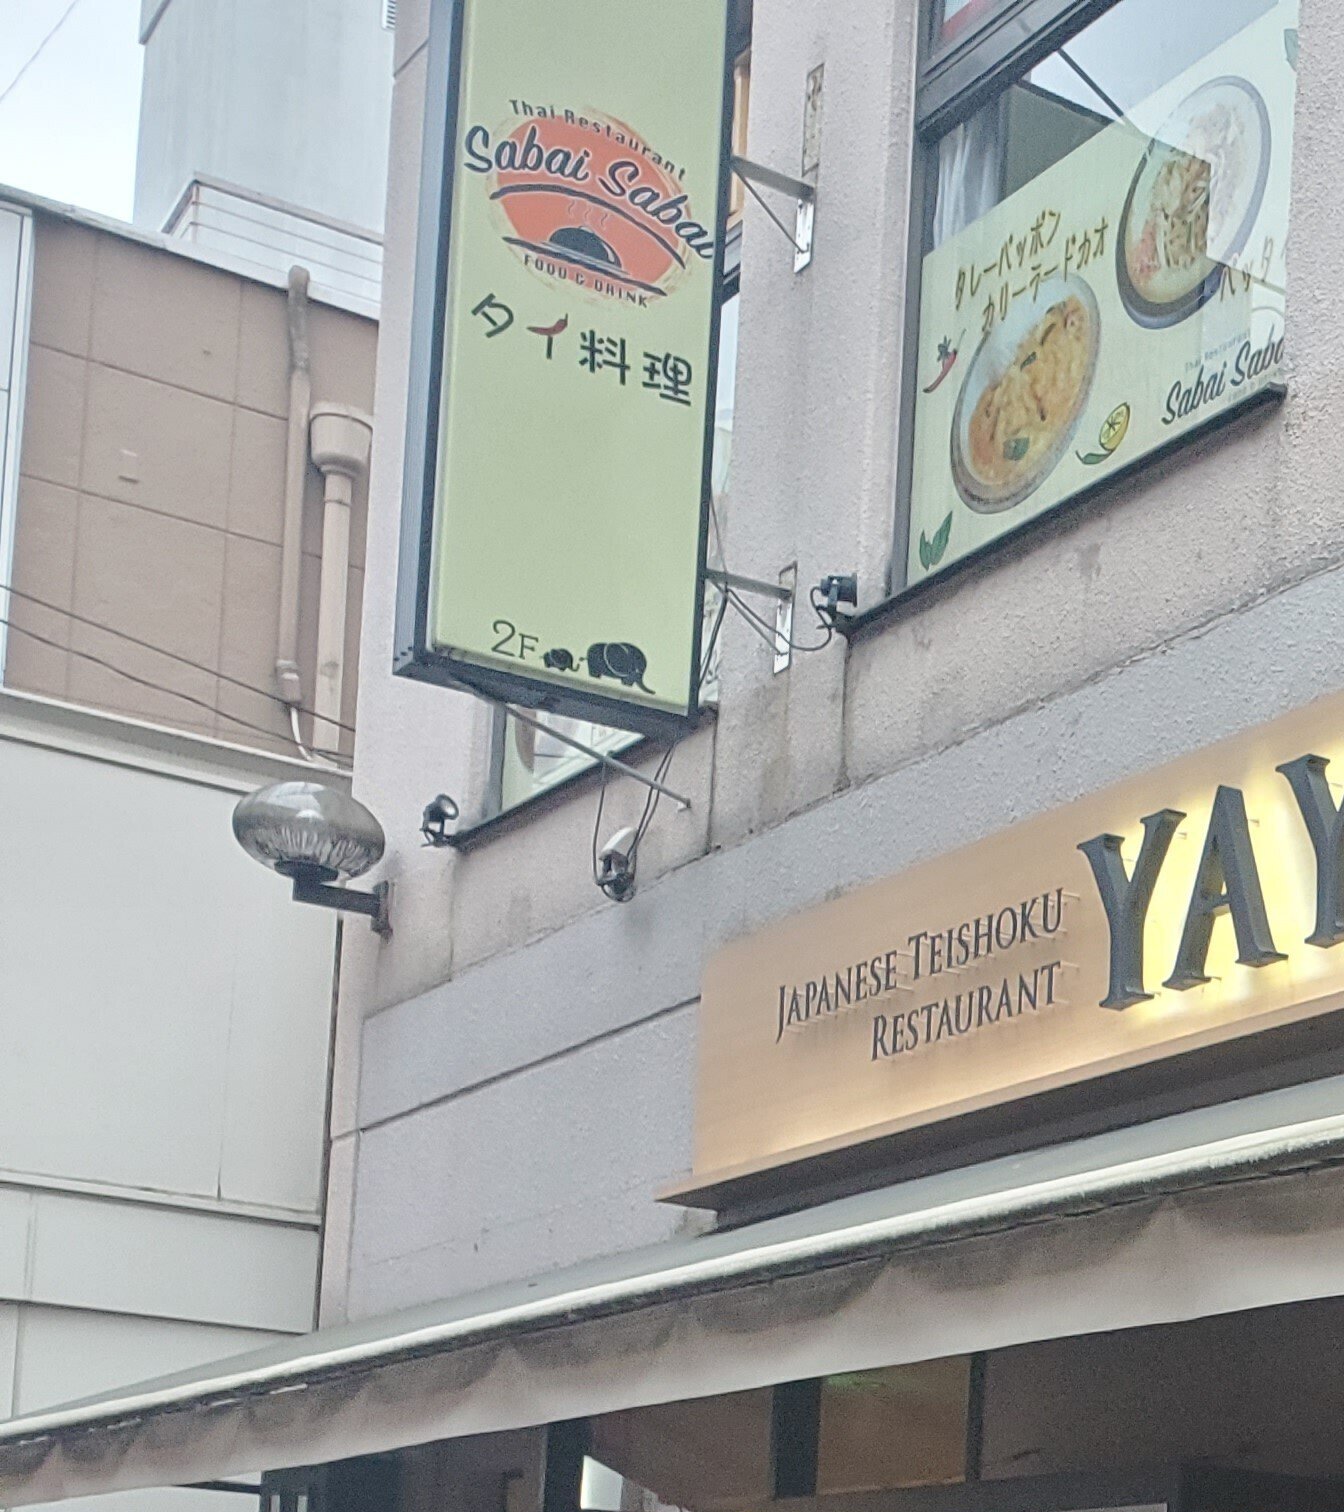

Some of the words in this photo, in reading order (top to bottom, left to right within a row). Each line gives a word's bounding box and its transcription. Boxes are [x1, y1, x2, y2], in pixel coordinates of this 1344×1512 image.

[463, 125, 591, 182] Sabai
[509, 99, 557, 120] Thai
[564, 108, 687, 182] Restaurant
[594, 277, 649, 309] DRINK
[470, 292, 693, 406] タイ料理
[1161, 360, 1228, 425] Sabai
[1230, 323, 1285, 387] Saba
[490, 619, 540, 661] 2F
[775, 949, 898, 1045] JAPANESE
[907, 887, 1064, 981] TEISHOKU
[870, 960, 1061, 1062] RESTAURANT
